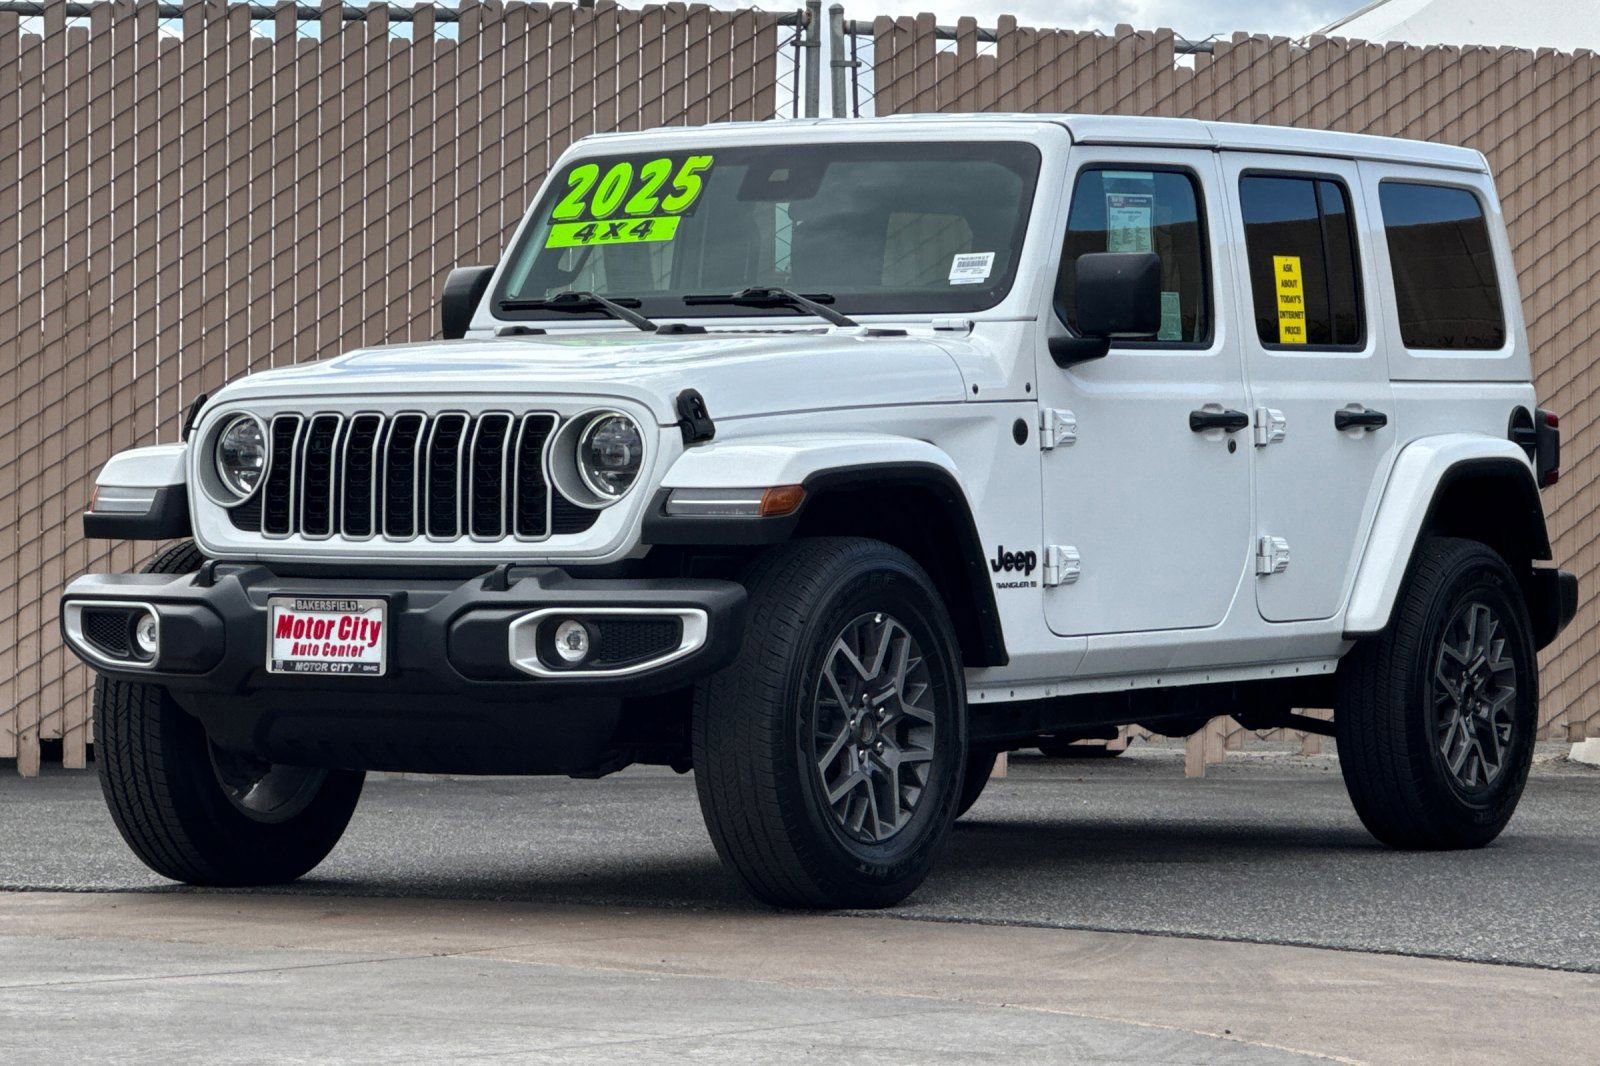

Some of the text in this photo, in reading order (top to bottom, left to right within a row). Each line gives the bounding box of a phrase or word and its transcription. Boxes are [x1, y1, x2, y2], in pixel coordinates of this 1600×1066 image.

[552, 155, 714, 220] 2025
[1282, 263, 1293, 272] ASK
[1281, 279, 1298, 288] ABOUT
[1280, 295, 1302, 304] TODAY'S
[1279, 310, 1304, 319] INTERNET
[990, 545, 1037, 576] Jeep
[296, 600, 357, 611] BAKERSFIELD
[275, 614, 382, 648] Motor City
[291, 642, 365, 658] Auto Center
[295, 661, 354, 673] MOTOR CITY
